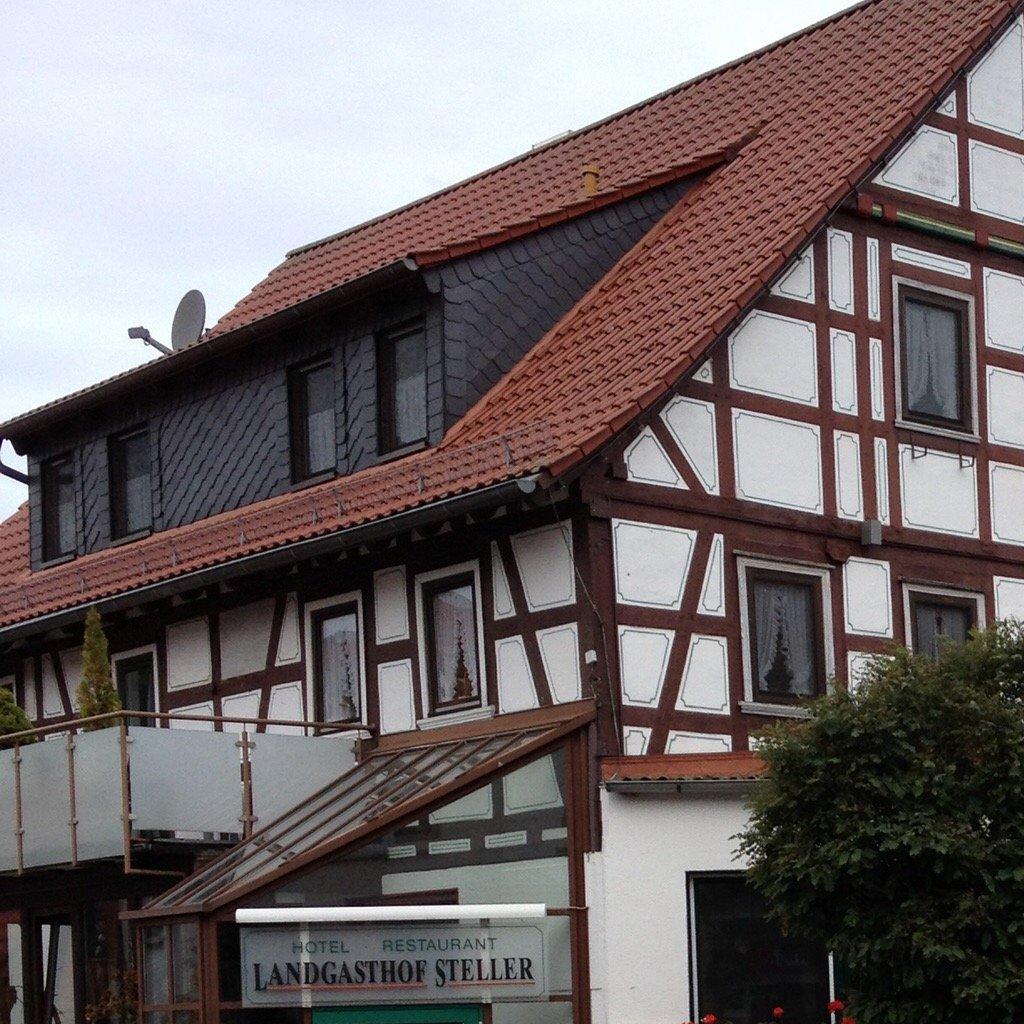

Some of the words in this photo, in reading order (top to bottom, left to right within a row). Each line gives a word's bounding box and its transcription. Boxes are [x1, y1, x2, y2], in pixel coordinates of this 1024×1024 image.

[291, 940, 350, 954] HOTEL
[382, 937, 498, 952] RESTAURANT
[253, 959, 427, 991] LANDGASTHOF
[435, 957, 536, 988] STELLER
